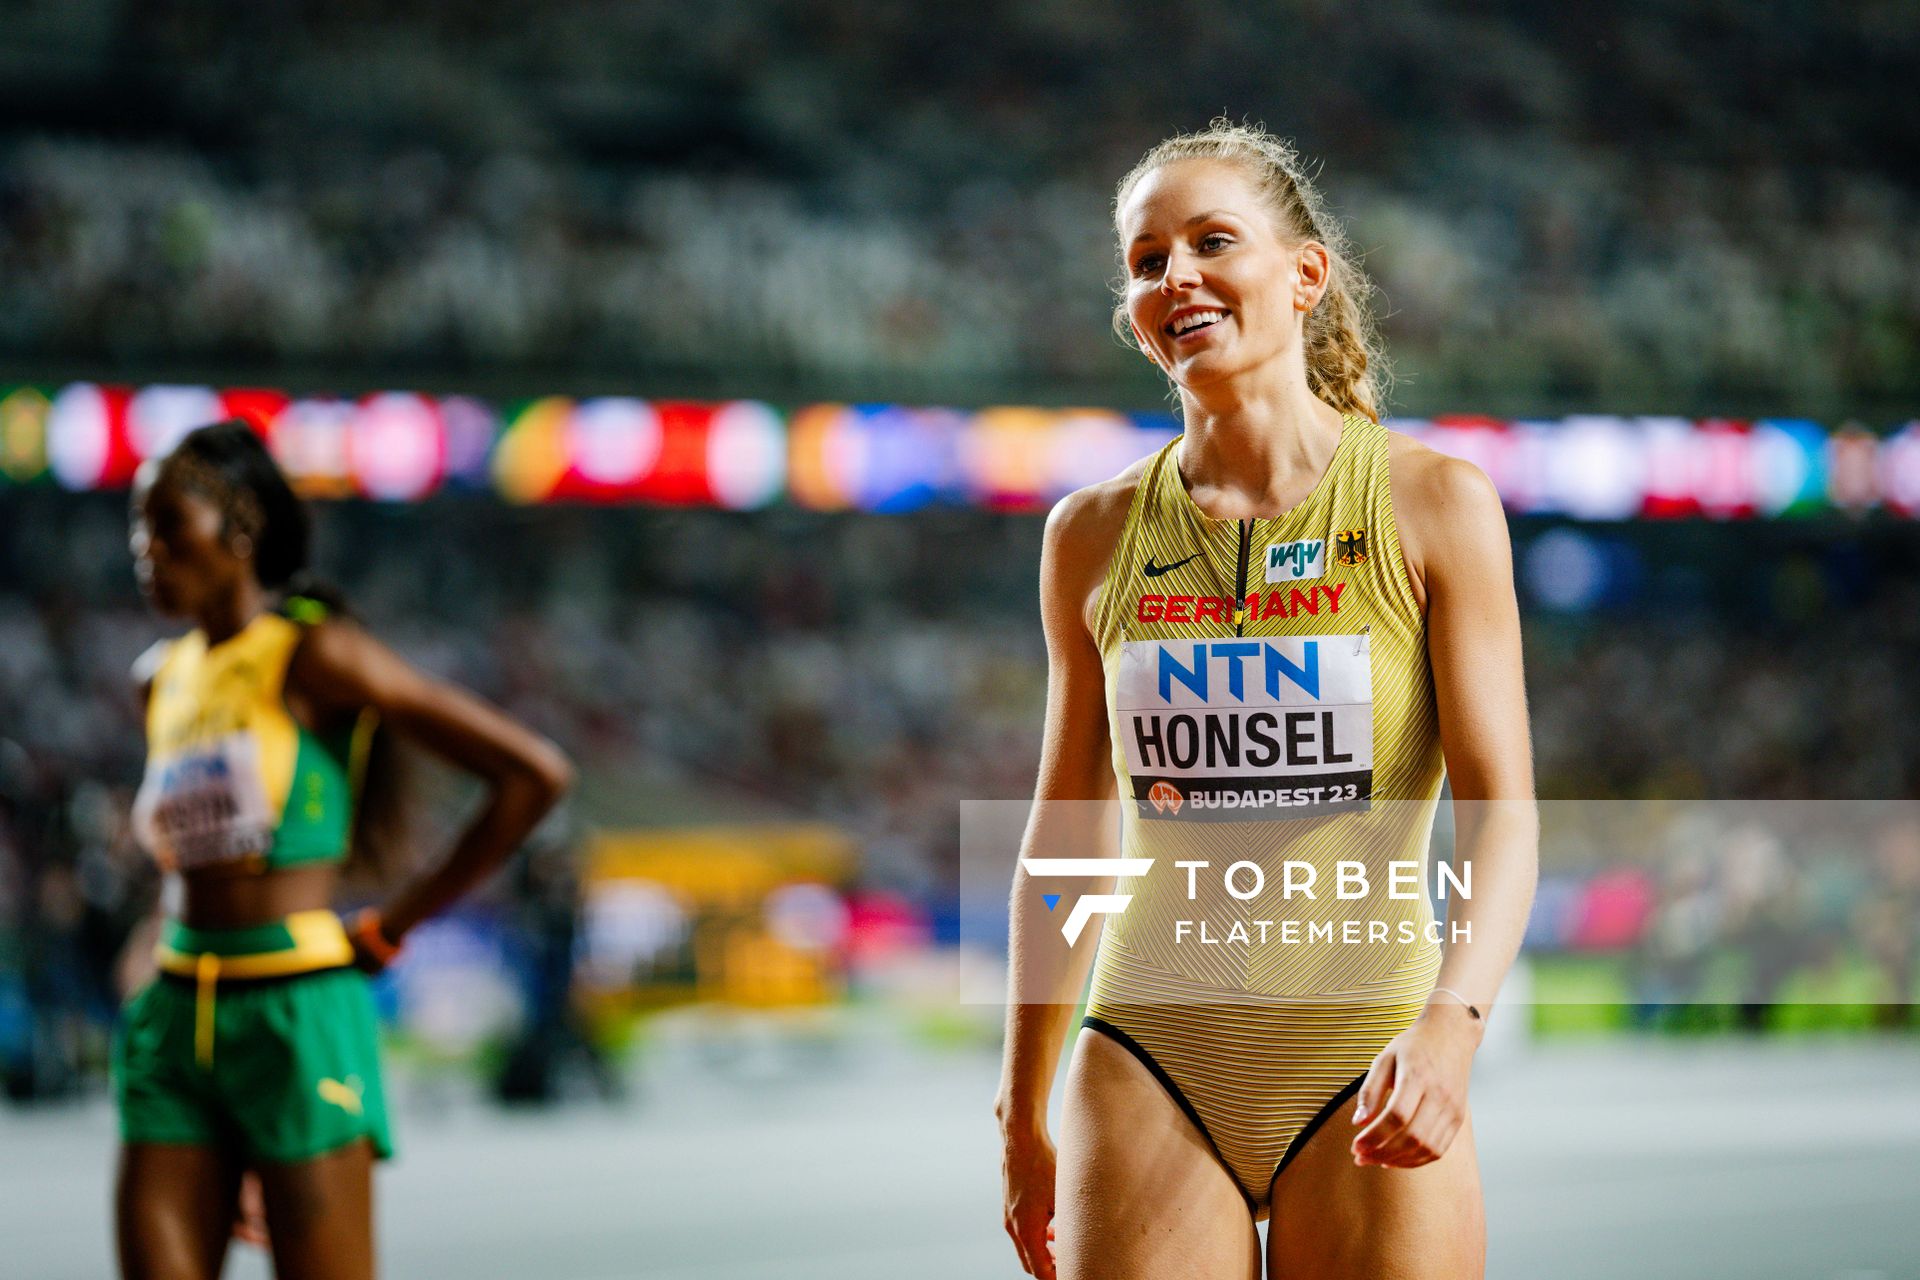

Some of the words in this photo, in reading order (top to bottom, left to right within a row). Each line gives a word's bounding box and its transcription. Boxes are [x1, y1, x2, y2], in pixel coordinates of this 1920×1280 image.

[1138, 583, 1345, 623] GERMANY
[1158, 642, 1320, 704] NTN
[1133, 712, 1353, 769] HONSEL
[1190, 787, 1325, 810] BUDAPEST
[1328, 784, 1358, 802] 23
